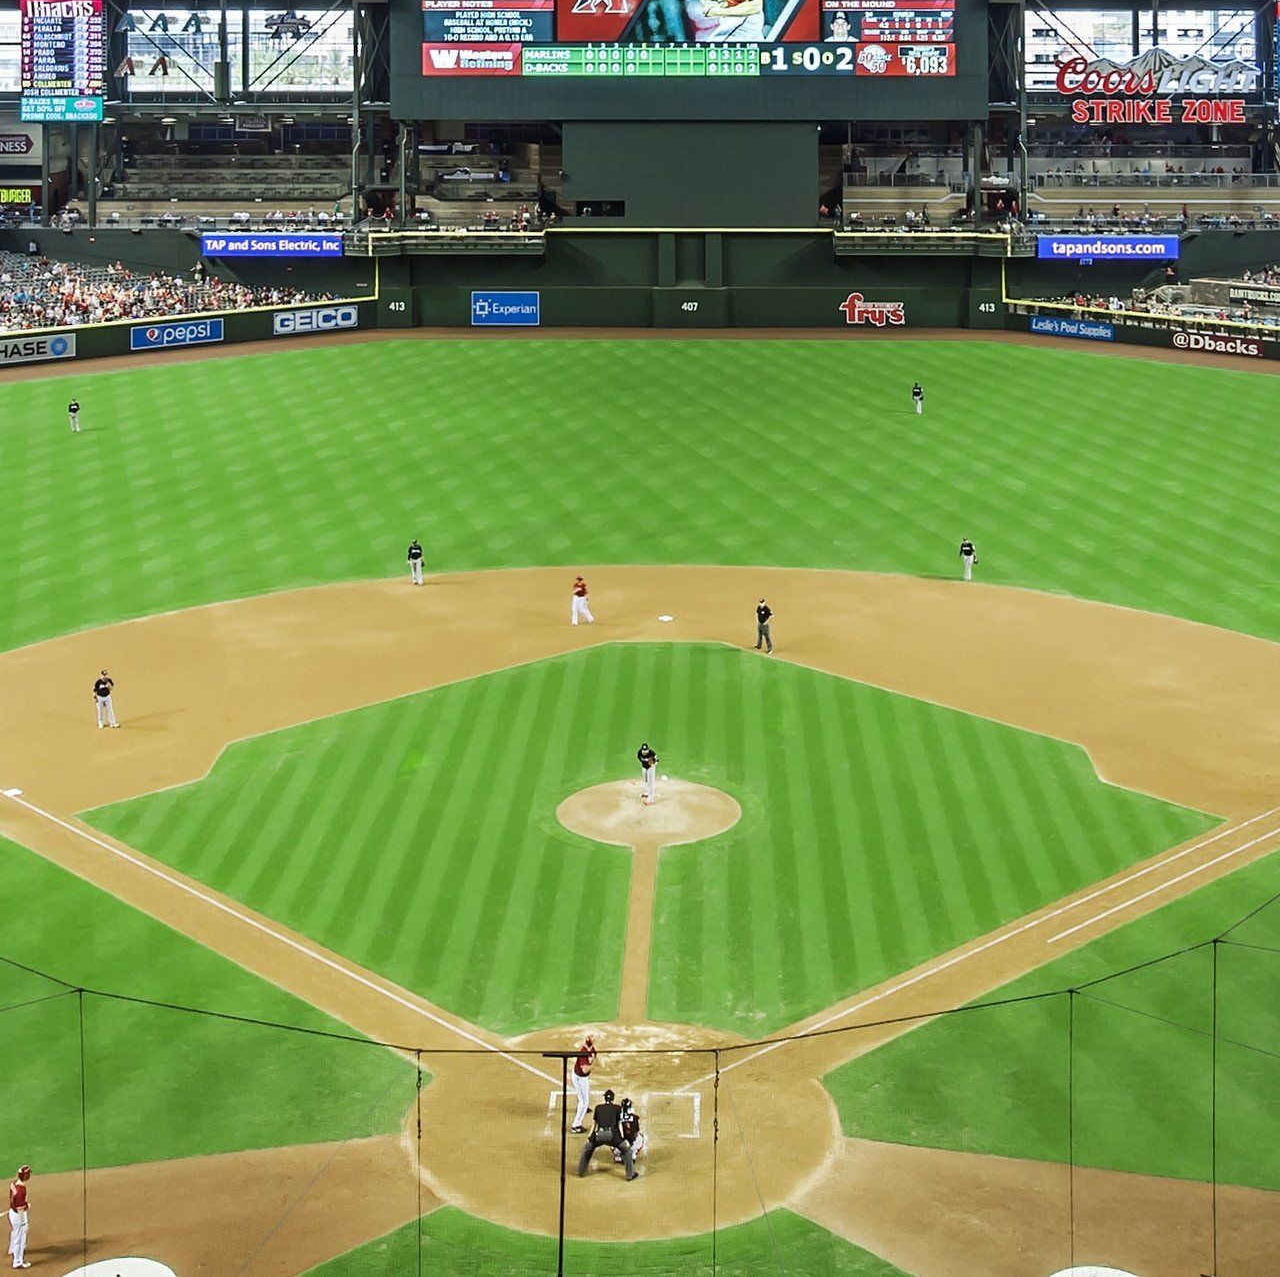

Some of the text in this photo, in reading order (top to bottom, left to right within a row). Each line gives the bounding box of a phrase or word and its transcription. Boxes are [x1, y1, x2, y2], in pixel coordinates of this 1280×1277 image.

[772, 48, 788, 70] 1
[792, 52, 803, 64] S
[803, 47, 820, 71] 0
[836, 47, 853, 70] 2
[902, 56, 947, 75] $6,093
[1054, 58, 1261, 94] Coors LIGHT
[1072, 99, 1245, 122] STRIKE ZONE
[206, 241, 339, 251] TAP and Sons Electric, Inc
[1052, 241, 1164, 256] tapandsons.com
[389, 302, 405, 311] 413
[493, 303, 536, 315] Experian
[682, 303, 698, 311] 407
[979, 304, 995, 312] 413
[276, 309, 357, 331] GEICO
[1032, 319, 1111, 337] Leslie's Pool Supplies
[164, 322, 210, 344] pepsi
[1173, 333, 1258, 355] @Dbacks
